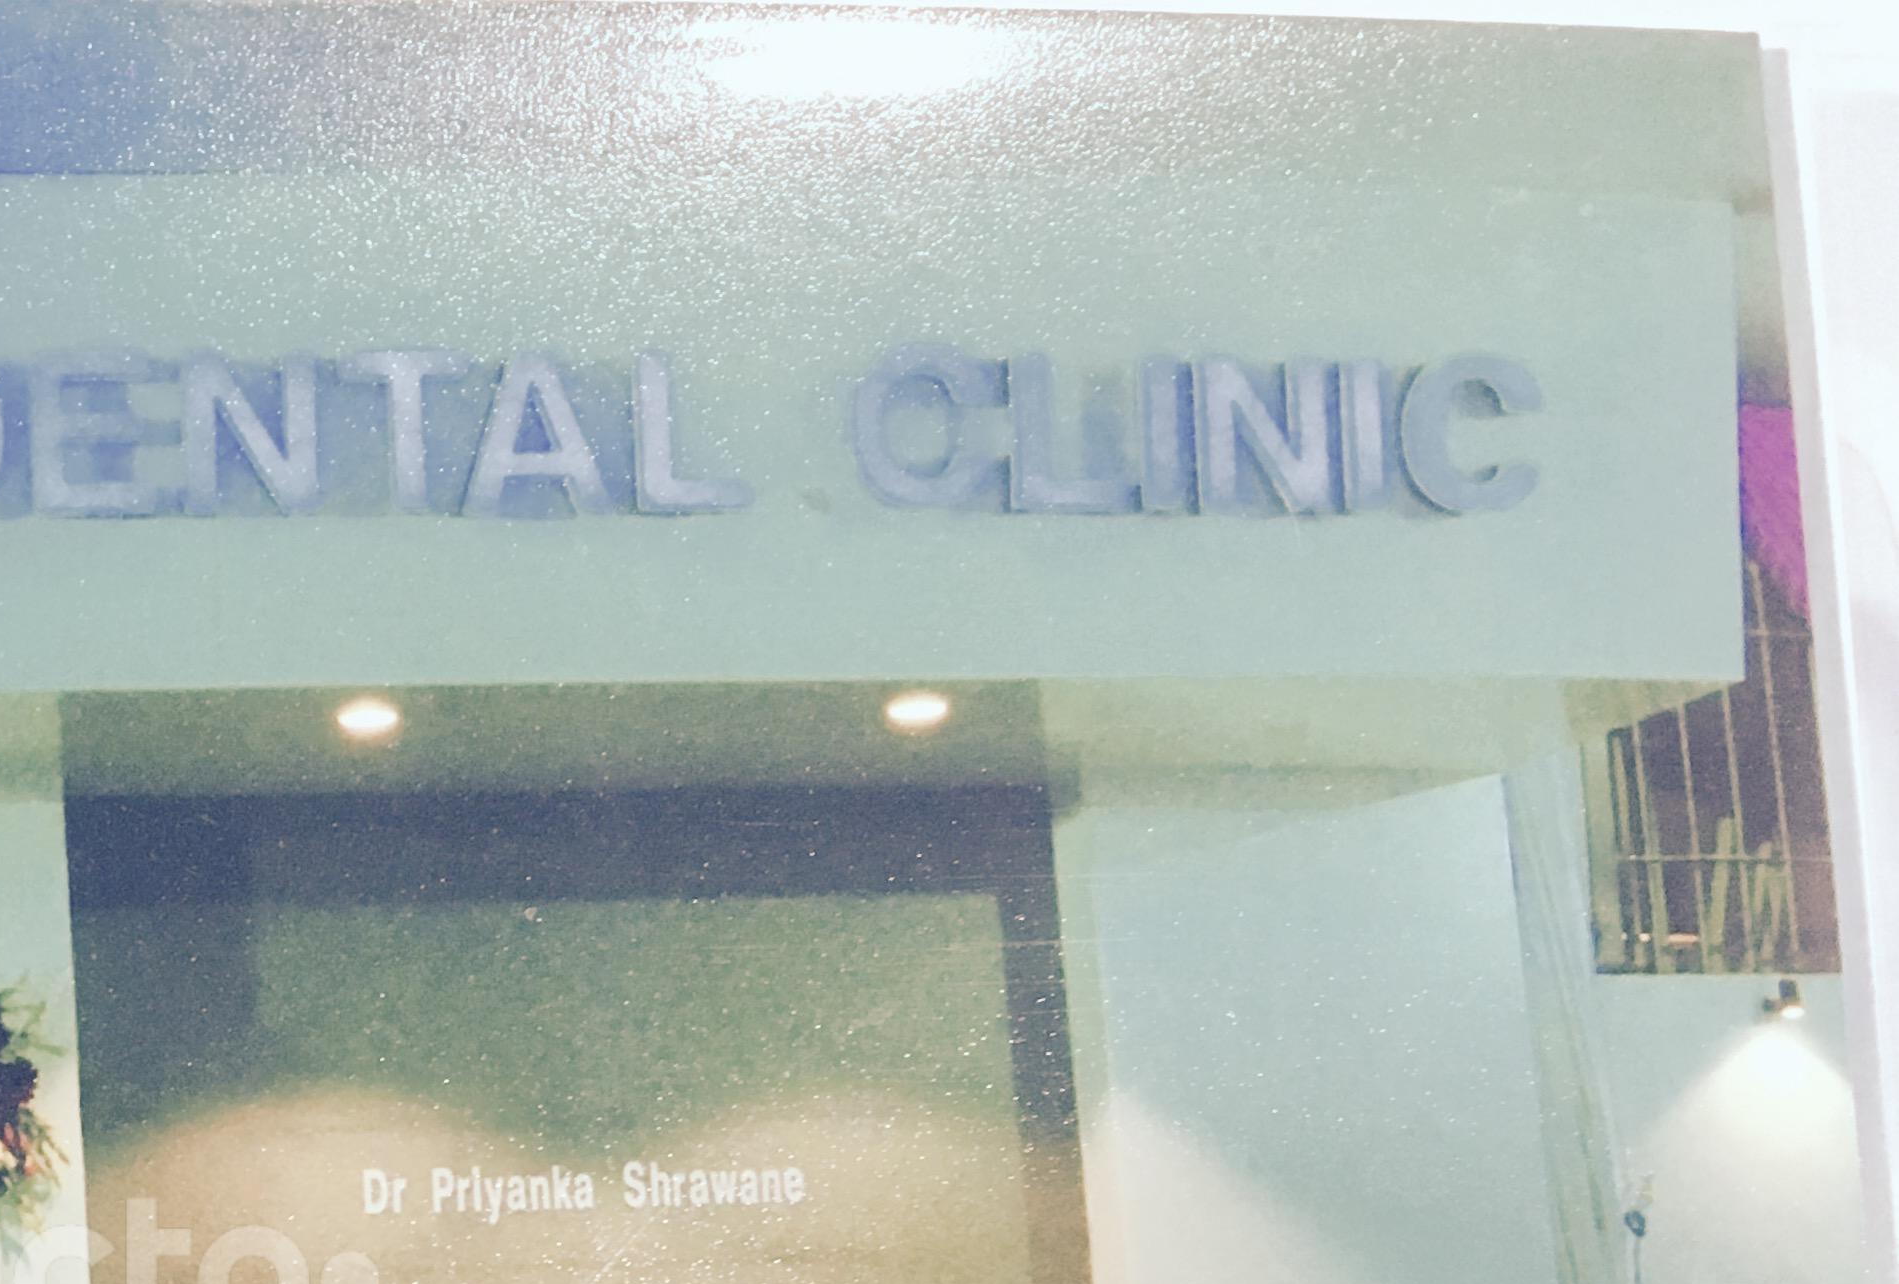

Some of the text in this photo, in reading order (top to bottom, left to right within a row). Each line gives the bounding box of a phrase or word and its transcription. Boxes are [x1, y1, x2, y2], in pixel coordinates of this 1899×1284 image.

[848, 341, 1544, 517] CLINIC
[362, 1160, 806, 1225] Dr Priyanka Shrawane
